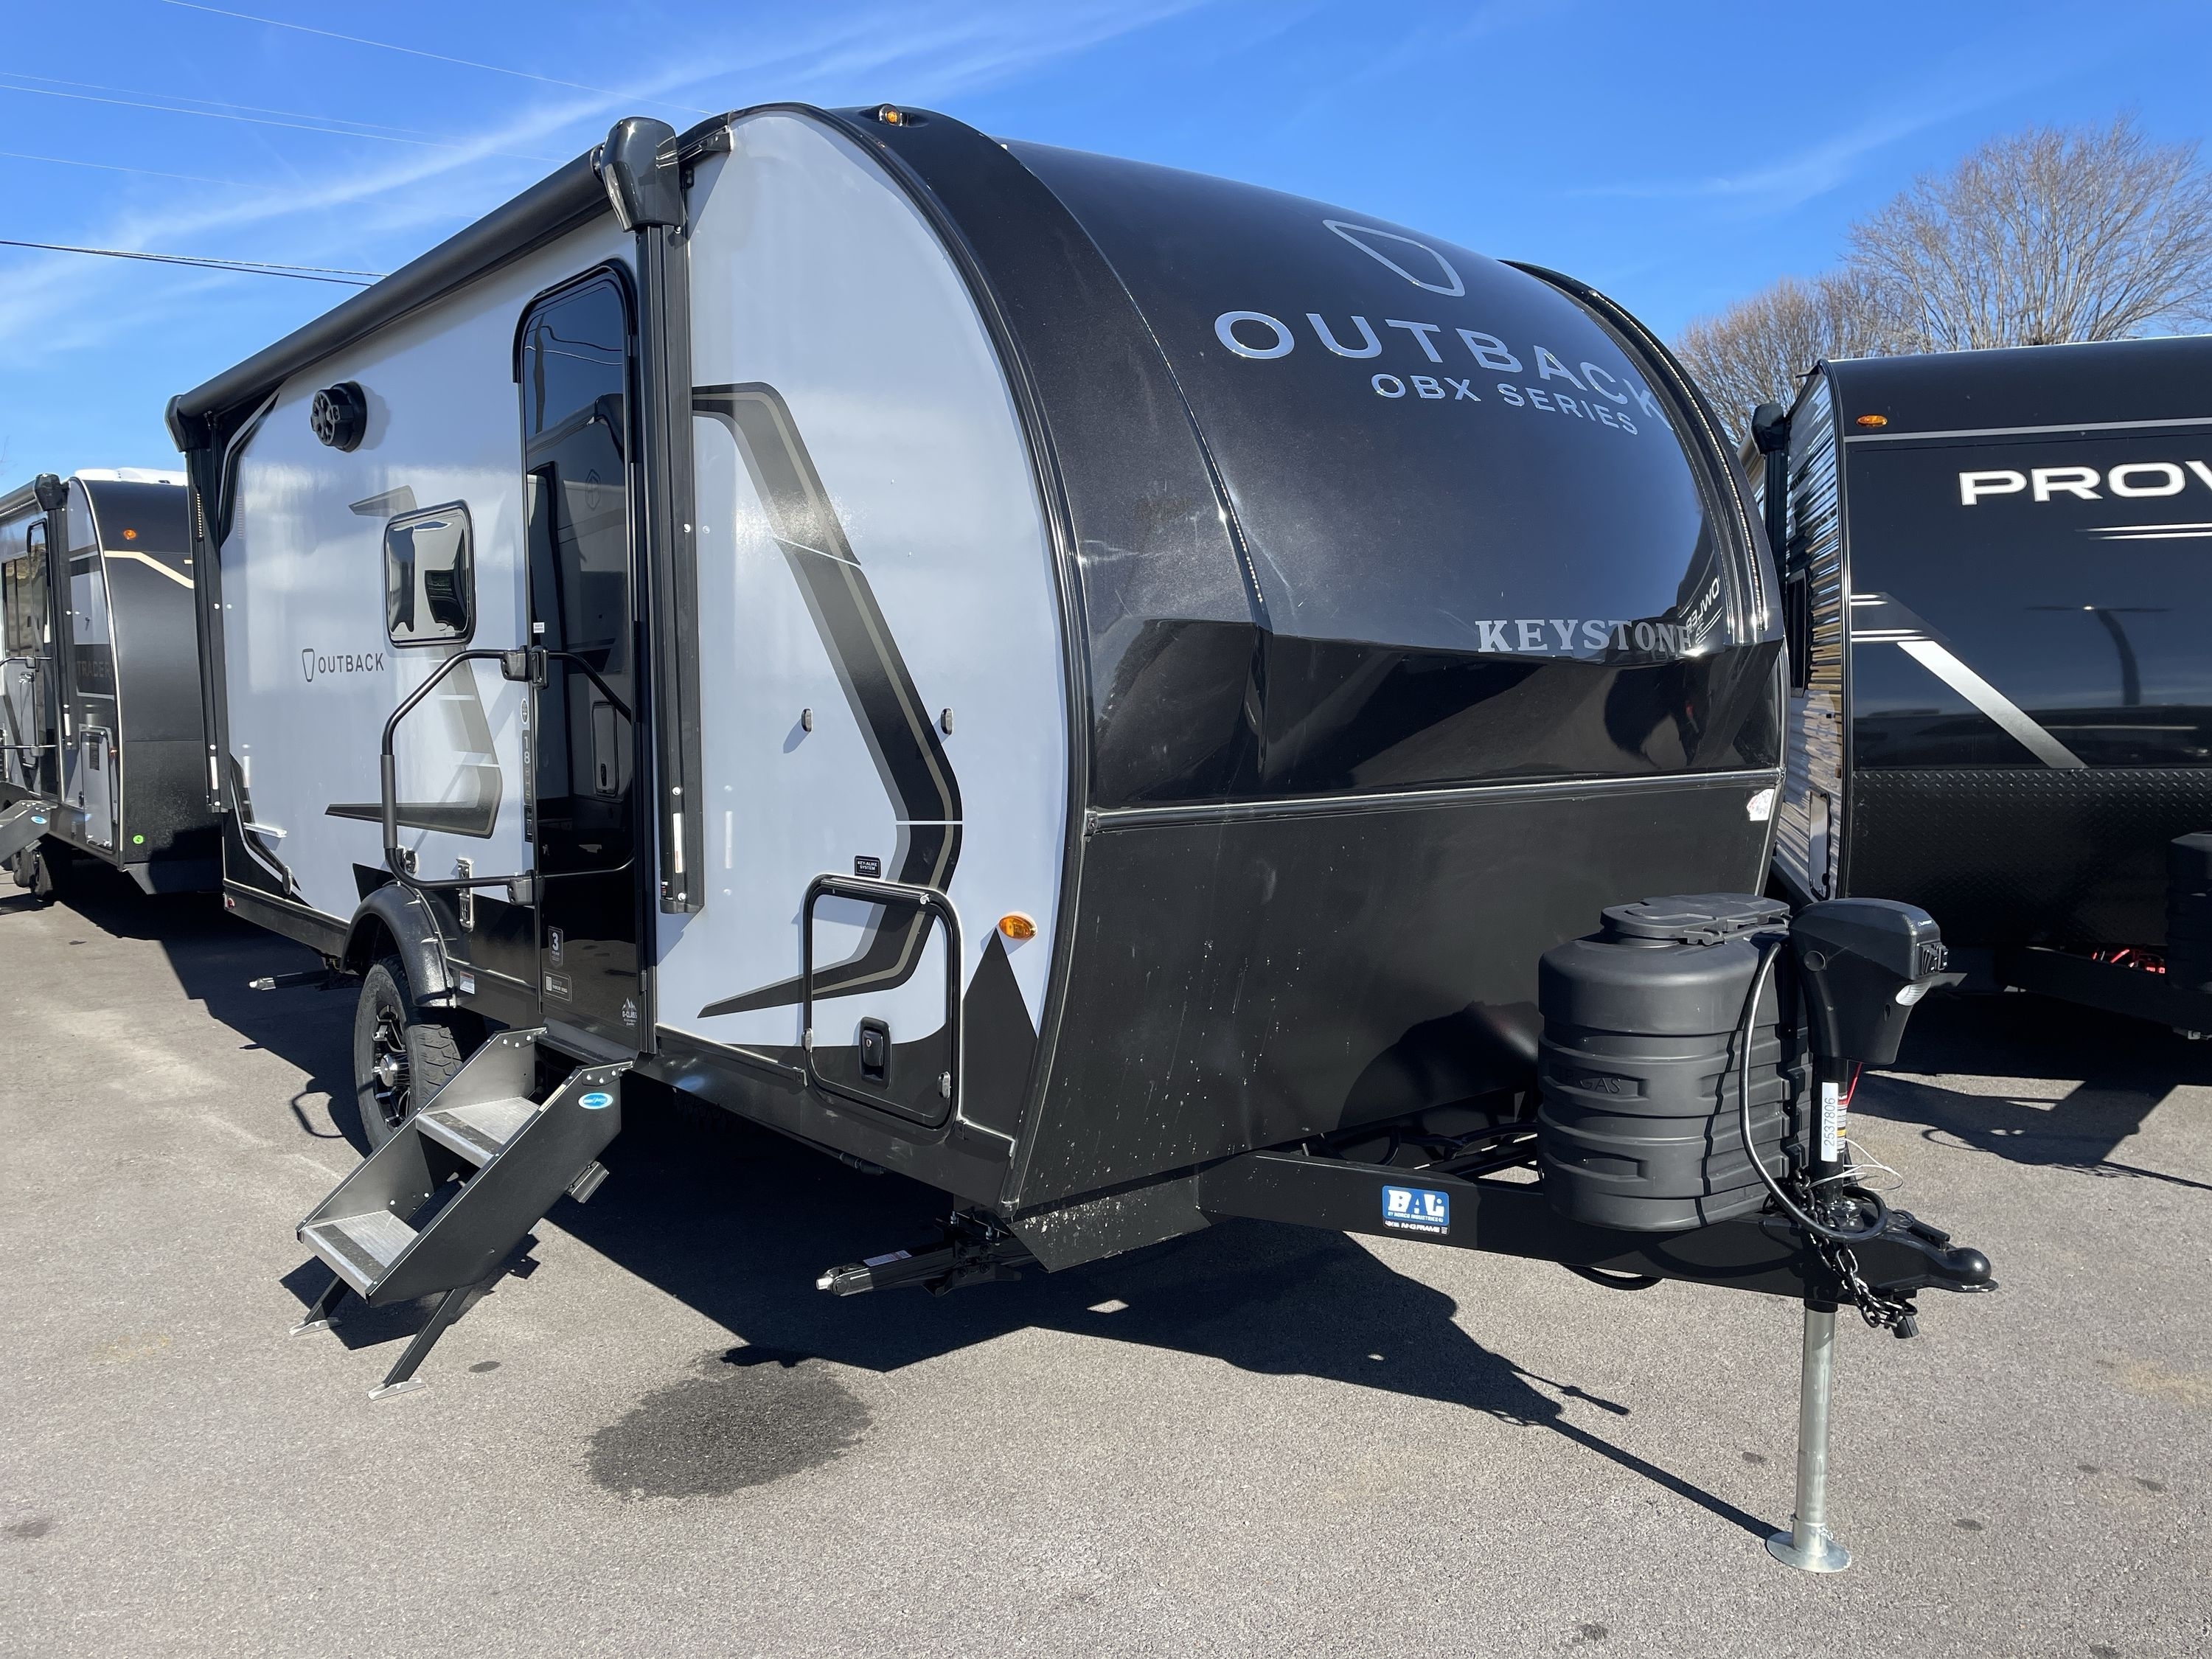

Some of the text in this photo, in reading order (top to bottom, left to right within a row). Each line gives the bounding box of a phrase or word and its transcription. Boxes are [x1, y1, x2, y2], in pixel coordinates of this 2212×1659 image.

[1214, 310, 1674, 431] OUTBACK
[1371, 373, 1638, 436] OBX SERIES
[1475, 619, 1693, 654] KEYSTONE
[318, 653, 384, 674] OUTBACK
[552, 932, 559, 951] 3
[1580, 1077, 1621, 1093] GAS
[1824, 1097, 1835, 1147] 2537806
[1388, 1189, 1444, 1217] BAL
